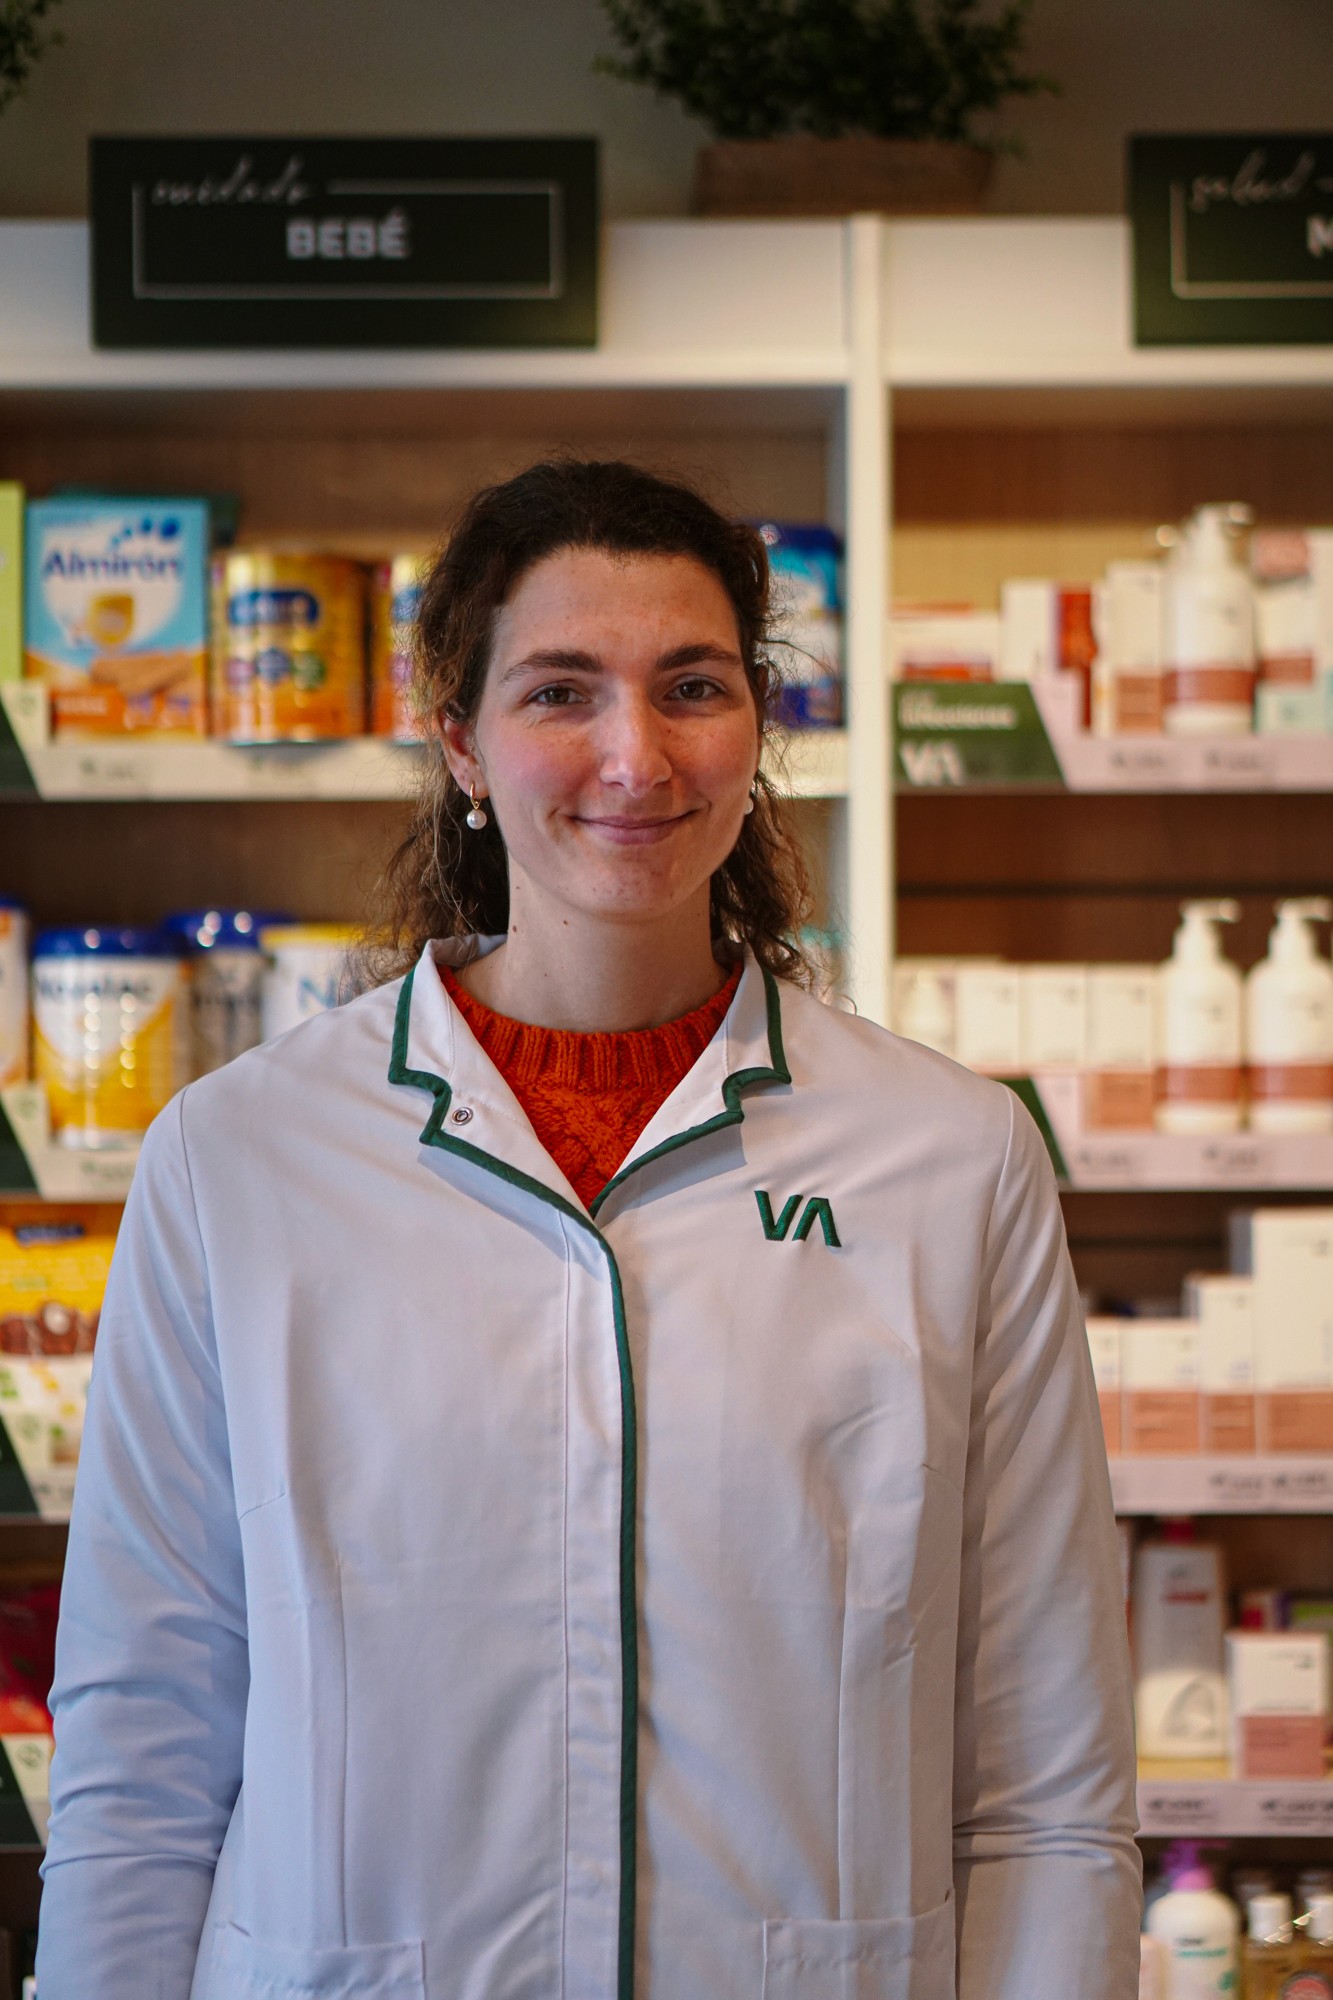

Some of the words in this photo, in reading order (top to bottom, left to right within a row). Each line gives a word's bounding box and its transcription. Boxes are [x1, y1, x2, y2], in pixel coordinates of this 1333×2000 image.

[286, 206, 408, 260] BEBÉ
[43, 550, 182, 580] Almirón
[754, 1190, 842, 1248] VA
